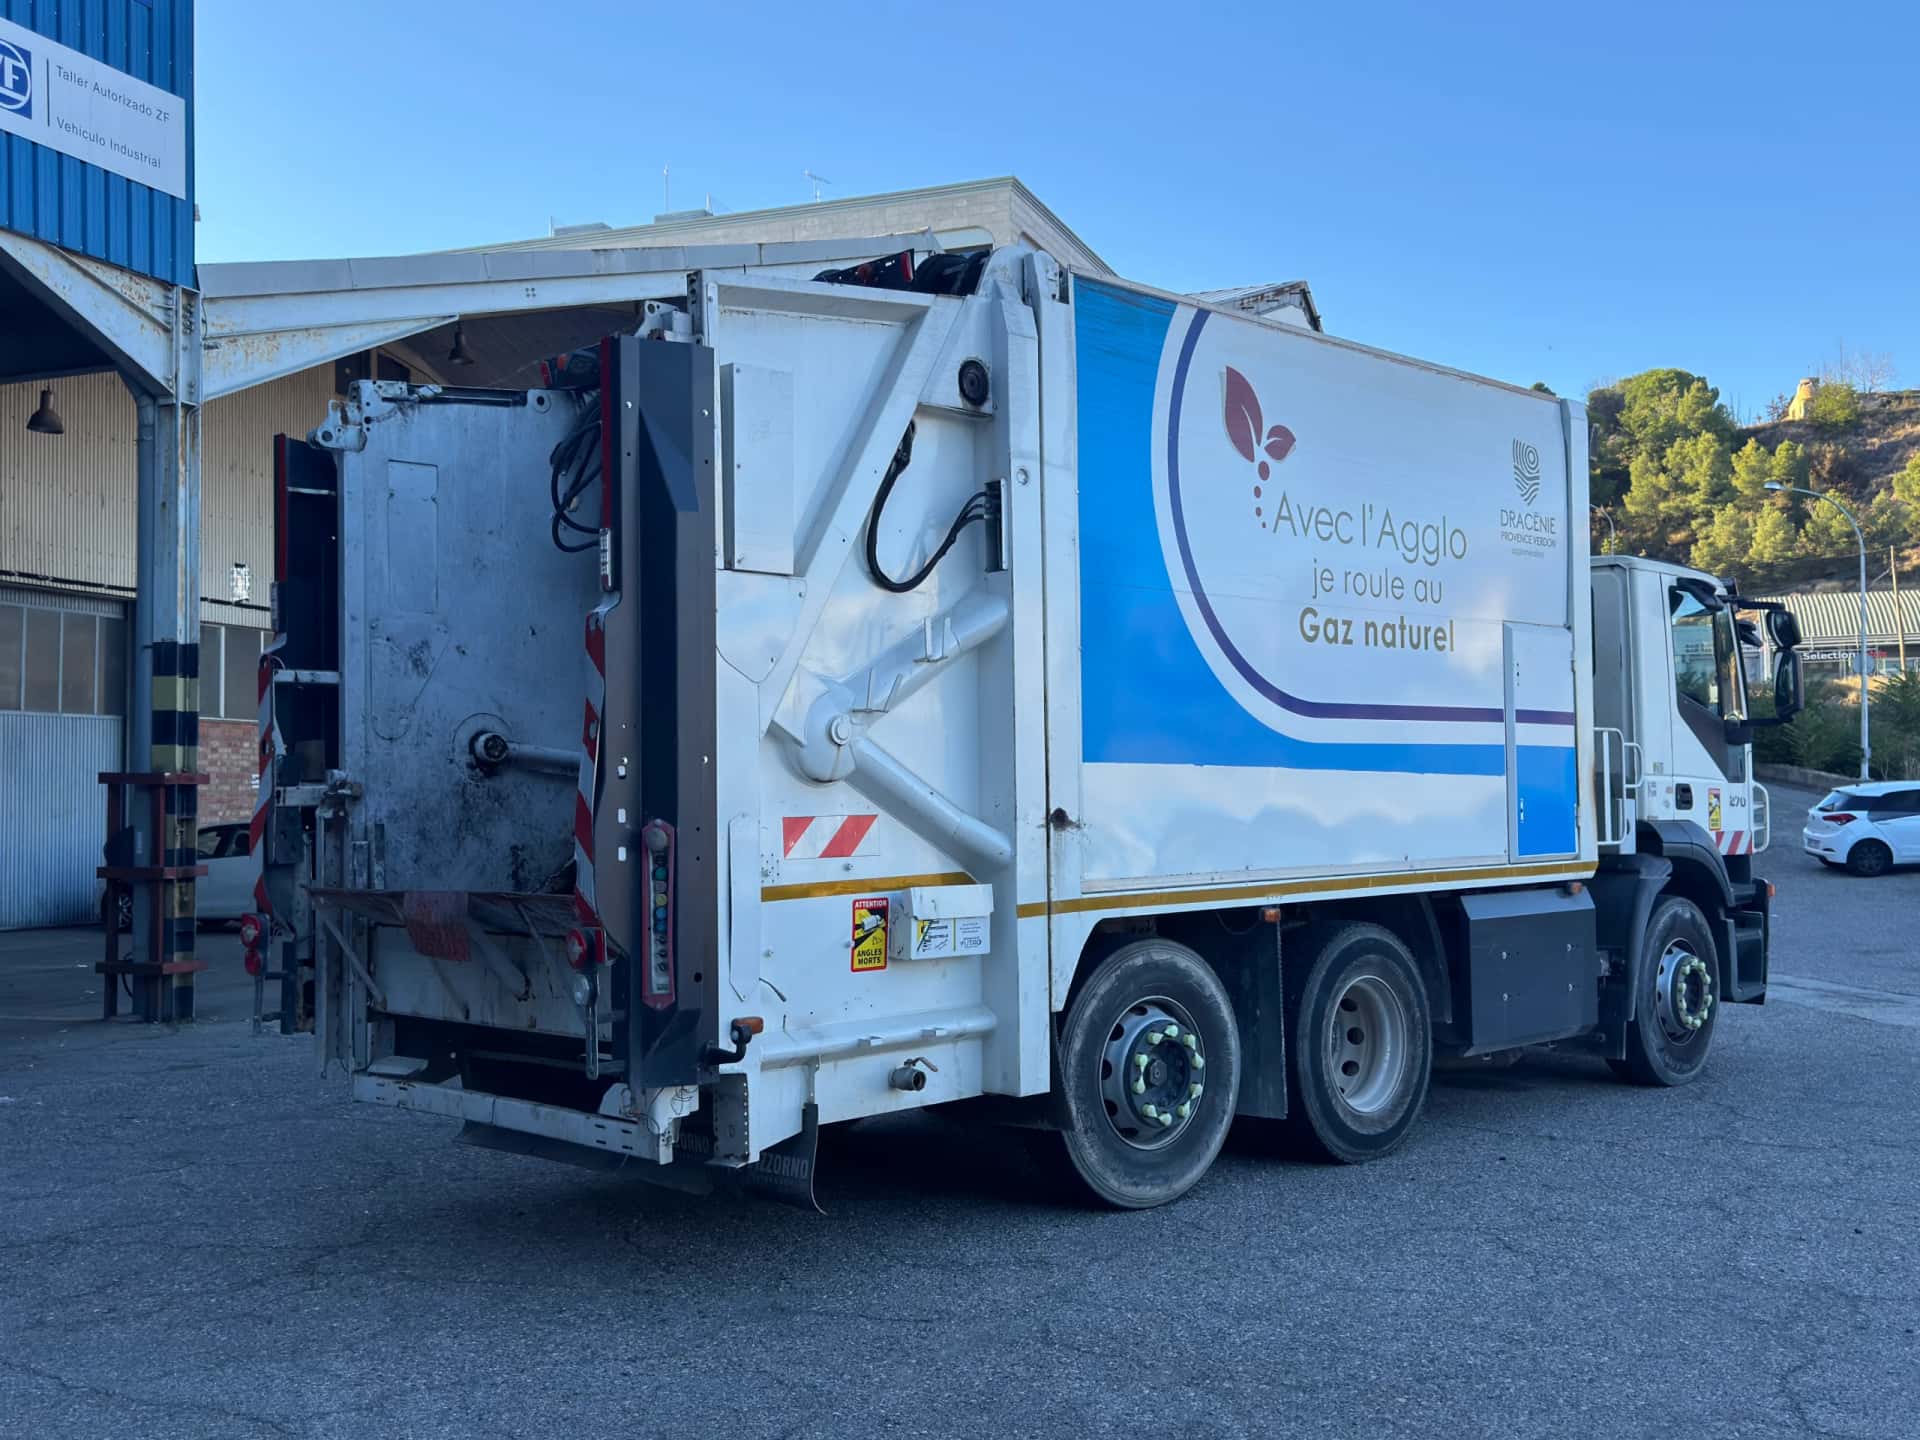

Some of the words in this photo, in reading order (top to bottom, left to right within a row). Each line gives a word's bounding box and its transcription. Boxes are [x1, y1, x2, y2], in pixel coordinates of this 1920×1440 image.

[56, 64, 88, 88] Taller
[93, 81, 152, 117] Autorizado
[155, 108, 170, 124] ZF
[110, 138, 161, 168] Industrial
[1272, 490, 1353, 544] Avec
[1361, 503, 1468, 567] l'Agglo
[1312, 557, 1334, 599] je
[1344, 568, 1405, 600] roule
[1414, 579, 1443, 604] au
[1299, 606, 1354, 645] Gaz
[1364, 615, 1455, 652] naturel
[857, 948, 881, 957] ANGLES
[857, 957, 881, 965] MORTS
